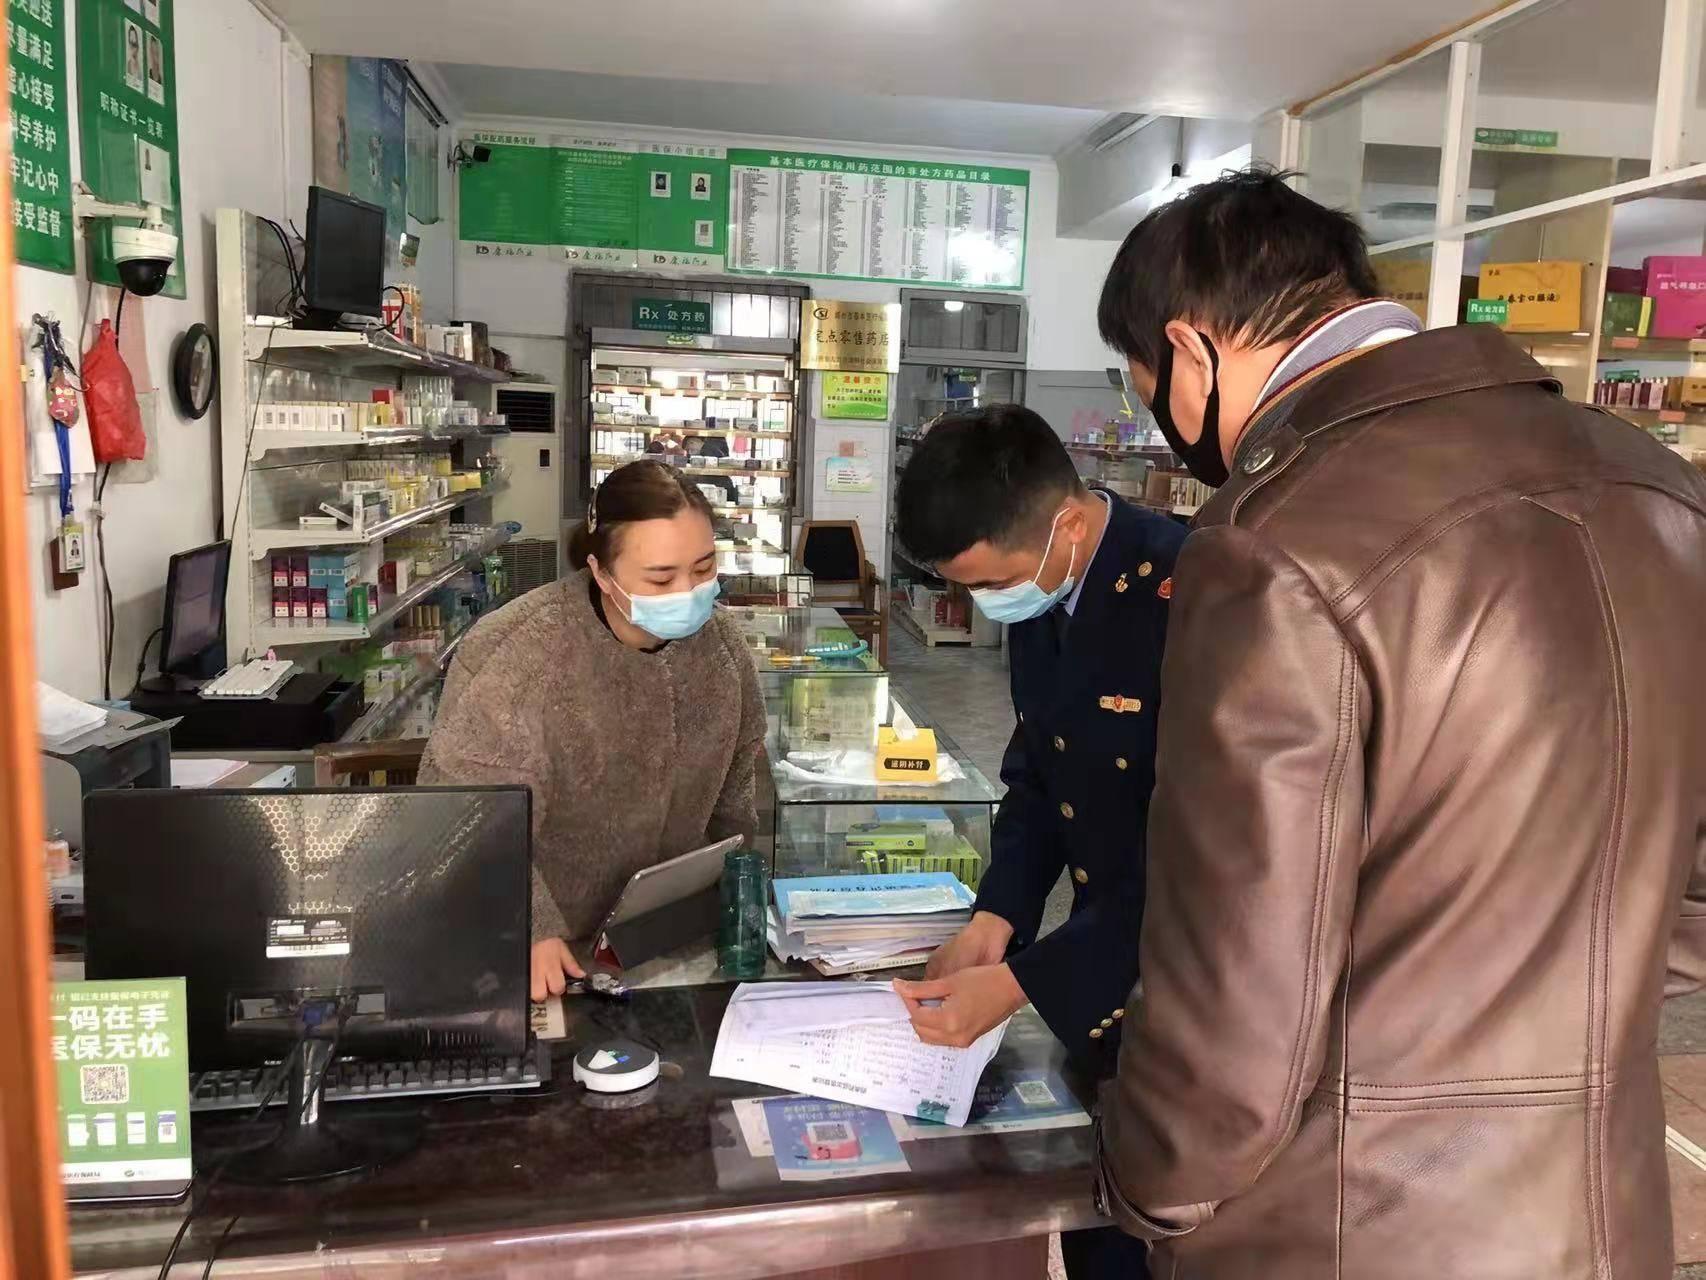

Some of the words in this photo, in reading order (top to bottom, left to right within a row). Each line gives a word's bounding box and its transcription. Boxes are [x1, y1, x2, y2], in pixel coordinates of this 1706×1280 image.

[769, 155, 991, 181] 基本医疗保险用药范围的非处方药品目录
[639, 306, 659, 320] Rx
[667, 310, 705, 323] 处方药
[49, 1003, 168, 1031] 一码在手
